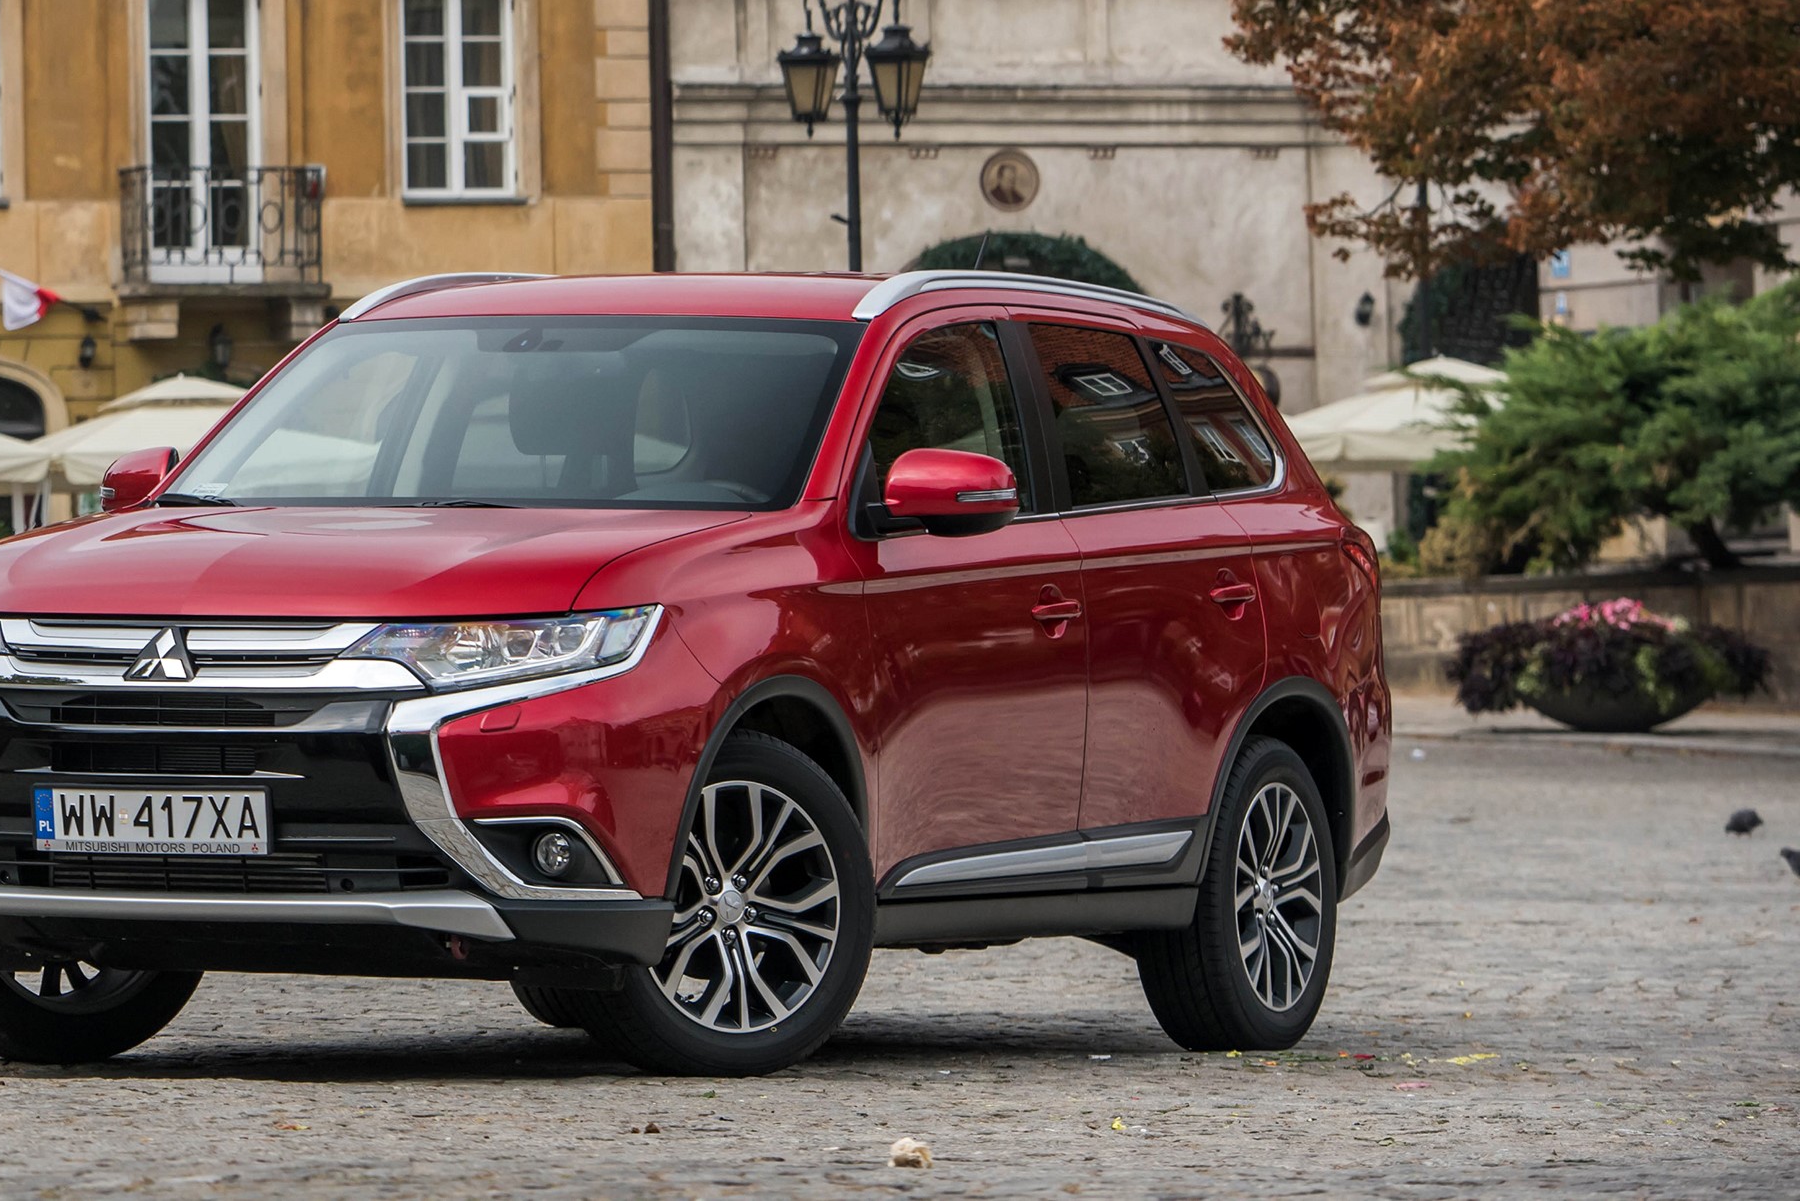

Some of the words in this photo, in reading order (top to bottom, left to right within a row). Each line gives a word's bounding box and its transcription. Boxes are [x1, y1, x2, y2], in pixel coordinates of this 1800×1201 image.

[60, 792, 116, 837] WW
[133, 793, 261, 839] 417XA
[38, 820, 53, 832] PL
[65, 841, 130, 853] MITSUBISHI
[136, 842, 187, 854] MOTORS
[192, 842, 241, 854] POLAND
